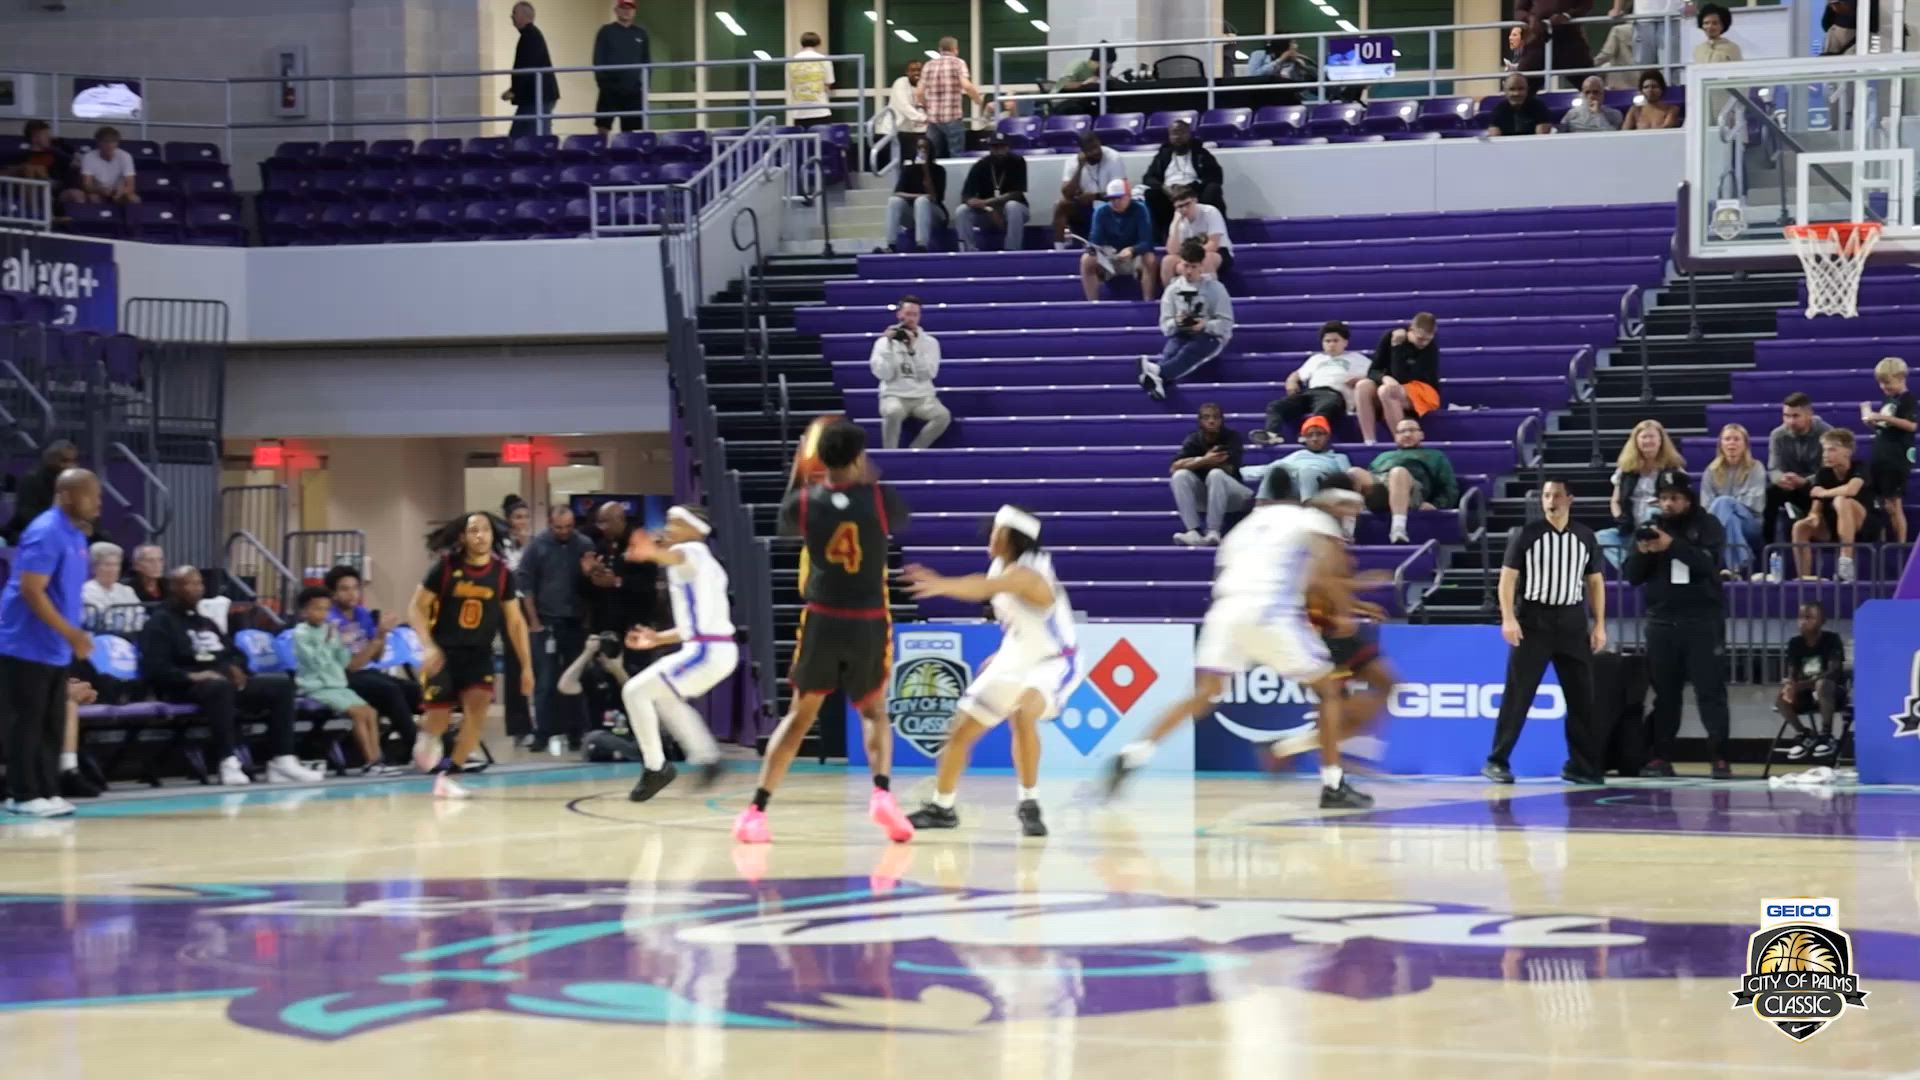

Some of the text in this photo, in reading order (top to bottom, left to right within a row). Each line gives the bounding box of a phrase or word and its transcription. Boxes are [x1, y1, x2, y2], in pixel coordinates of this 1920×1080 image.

[1354, 42, 1382, 59] 101
[826, 521, 862, 573] 4
[459, 599, 483, 629] 0
[903, 715, 950, 733] CLASSI
